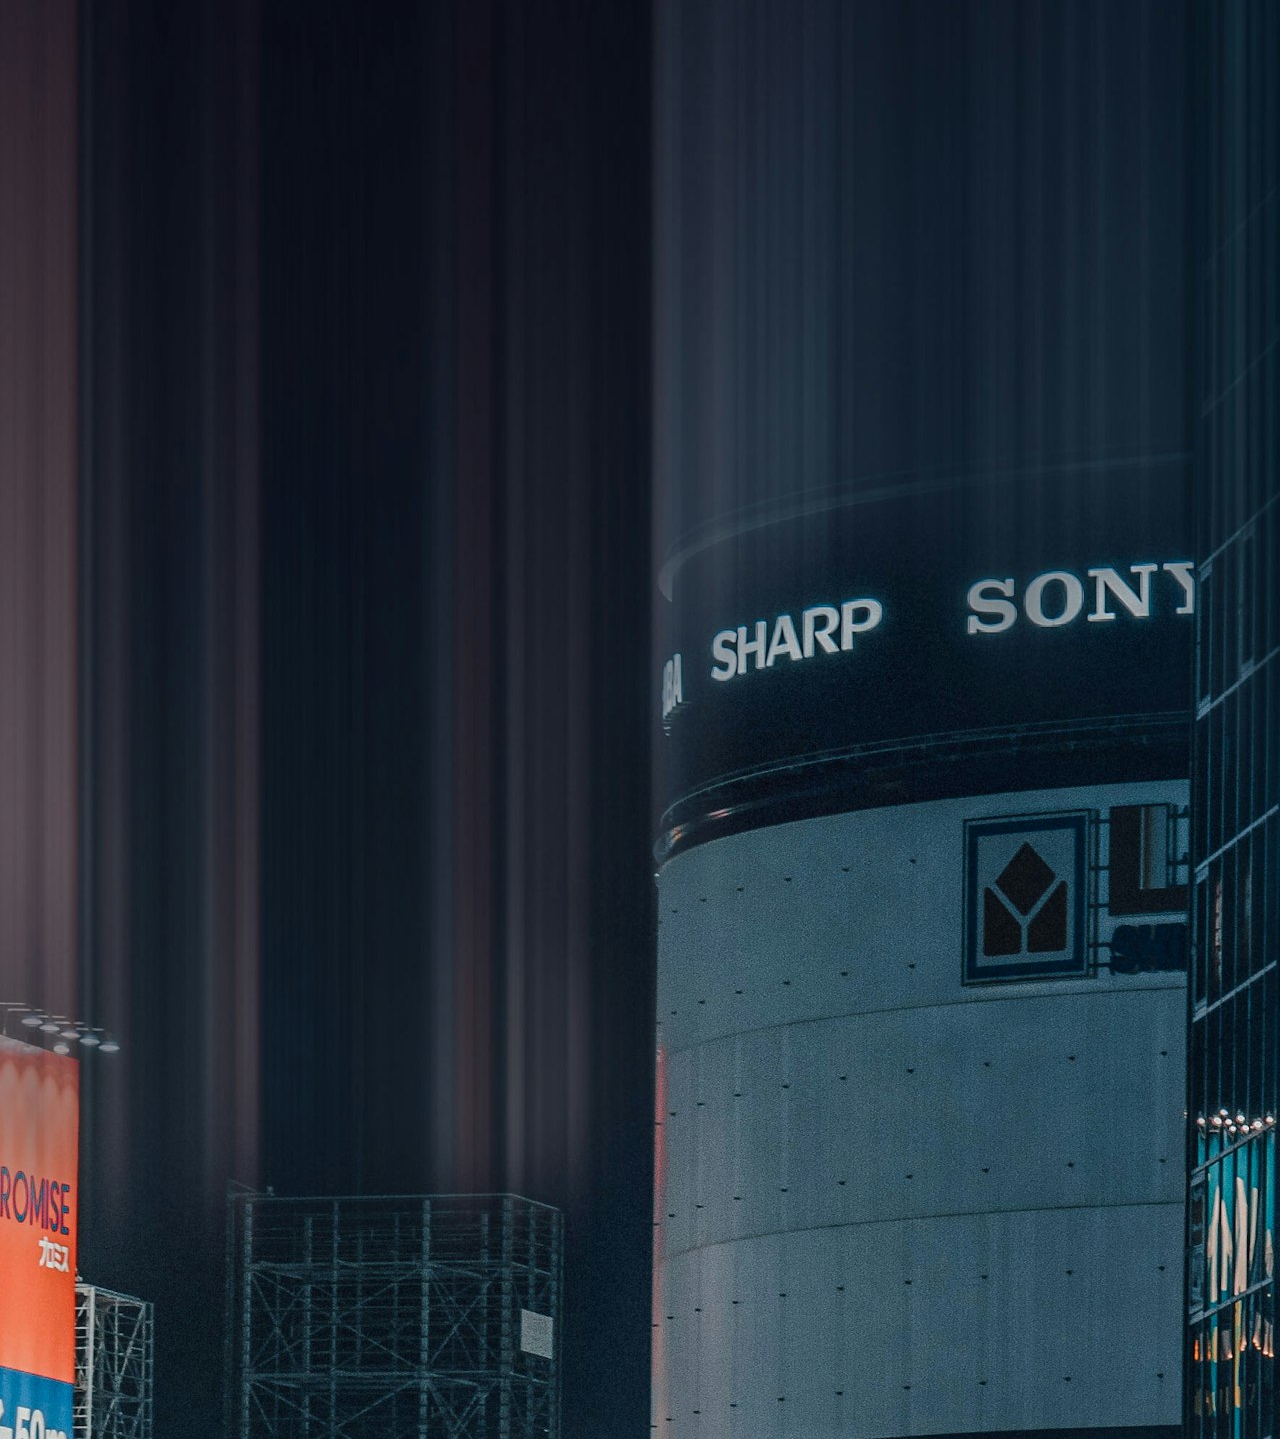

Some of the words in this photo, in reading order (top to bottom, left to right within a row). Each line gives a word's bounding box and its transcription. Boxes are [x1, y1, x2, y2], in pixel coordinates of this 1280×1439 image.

[711, 598, 883, 681] SHARP
[967, 561, 1195, 634] SONY
[38, 1236, 71, 1272] プロミス
